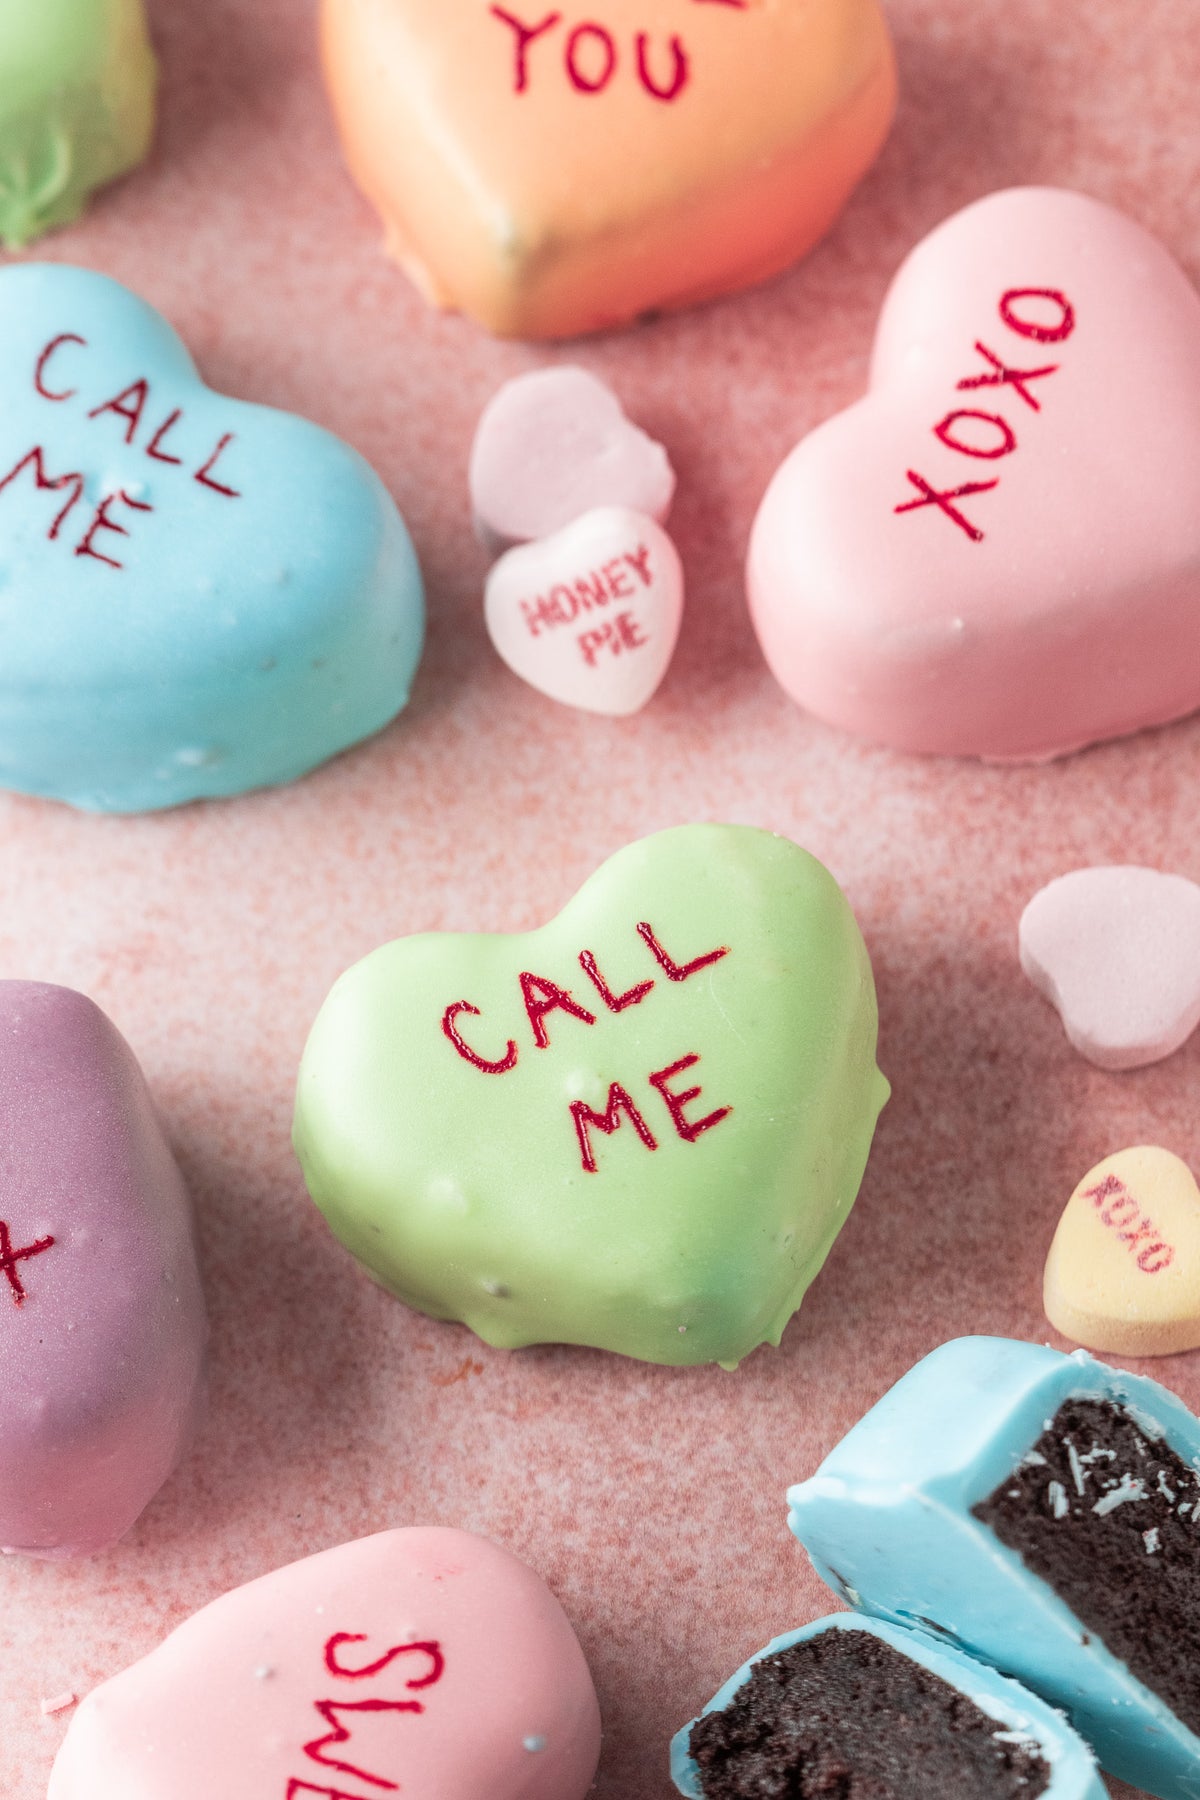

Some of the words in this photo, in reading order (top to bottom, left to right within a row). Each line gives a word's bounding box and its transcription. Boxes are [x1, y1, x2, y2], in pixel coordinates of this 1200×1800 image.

[488, 2, 693, 105] YOU
[34, 332, 242, 498] CALL
[892, 285, 1077, 544] XOXO
[0, 445, 155, 569] ME
[518, 542, 655, 639] HONEY
[576, 611, 651, 669] PIE
[440, 921, 733, 1075] CALL
[568, 1051, 734, 1175] ME
[1079, 1173, 1176, 1275] XOXO
